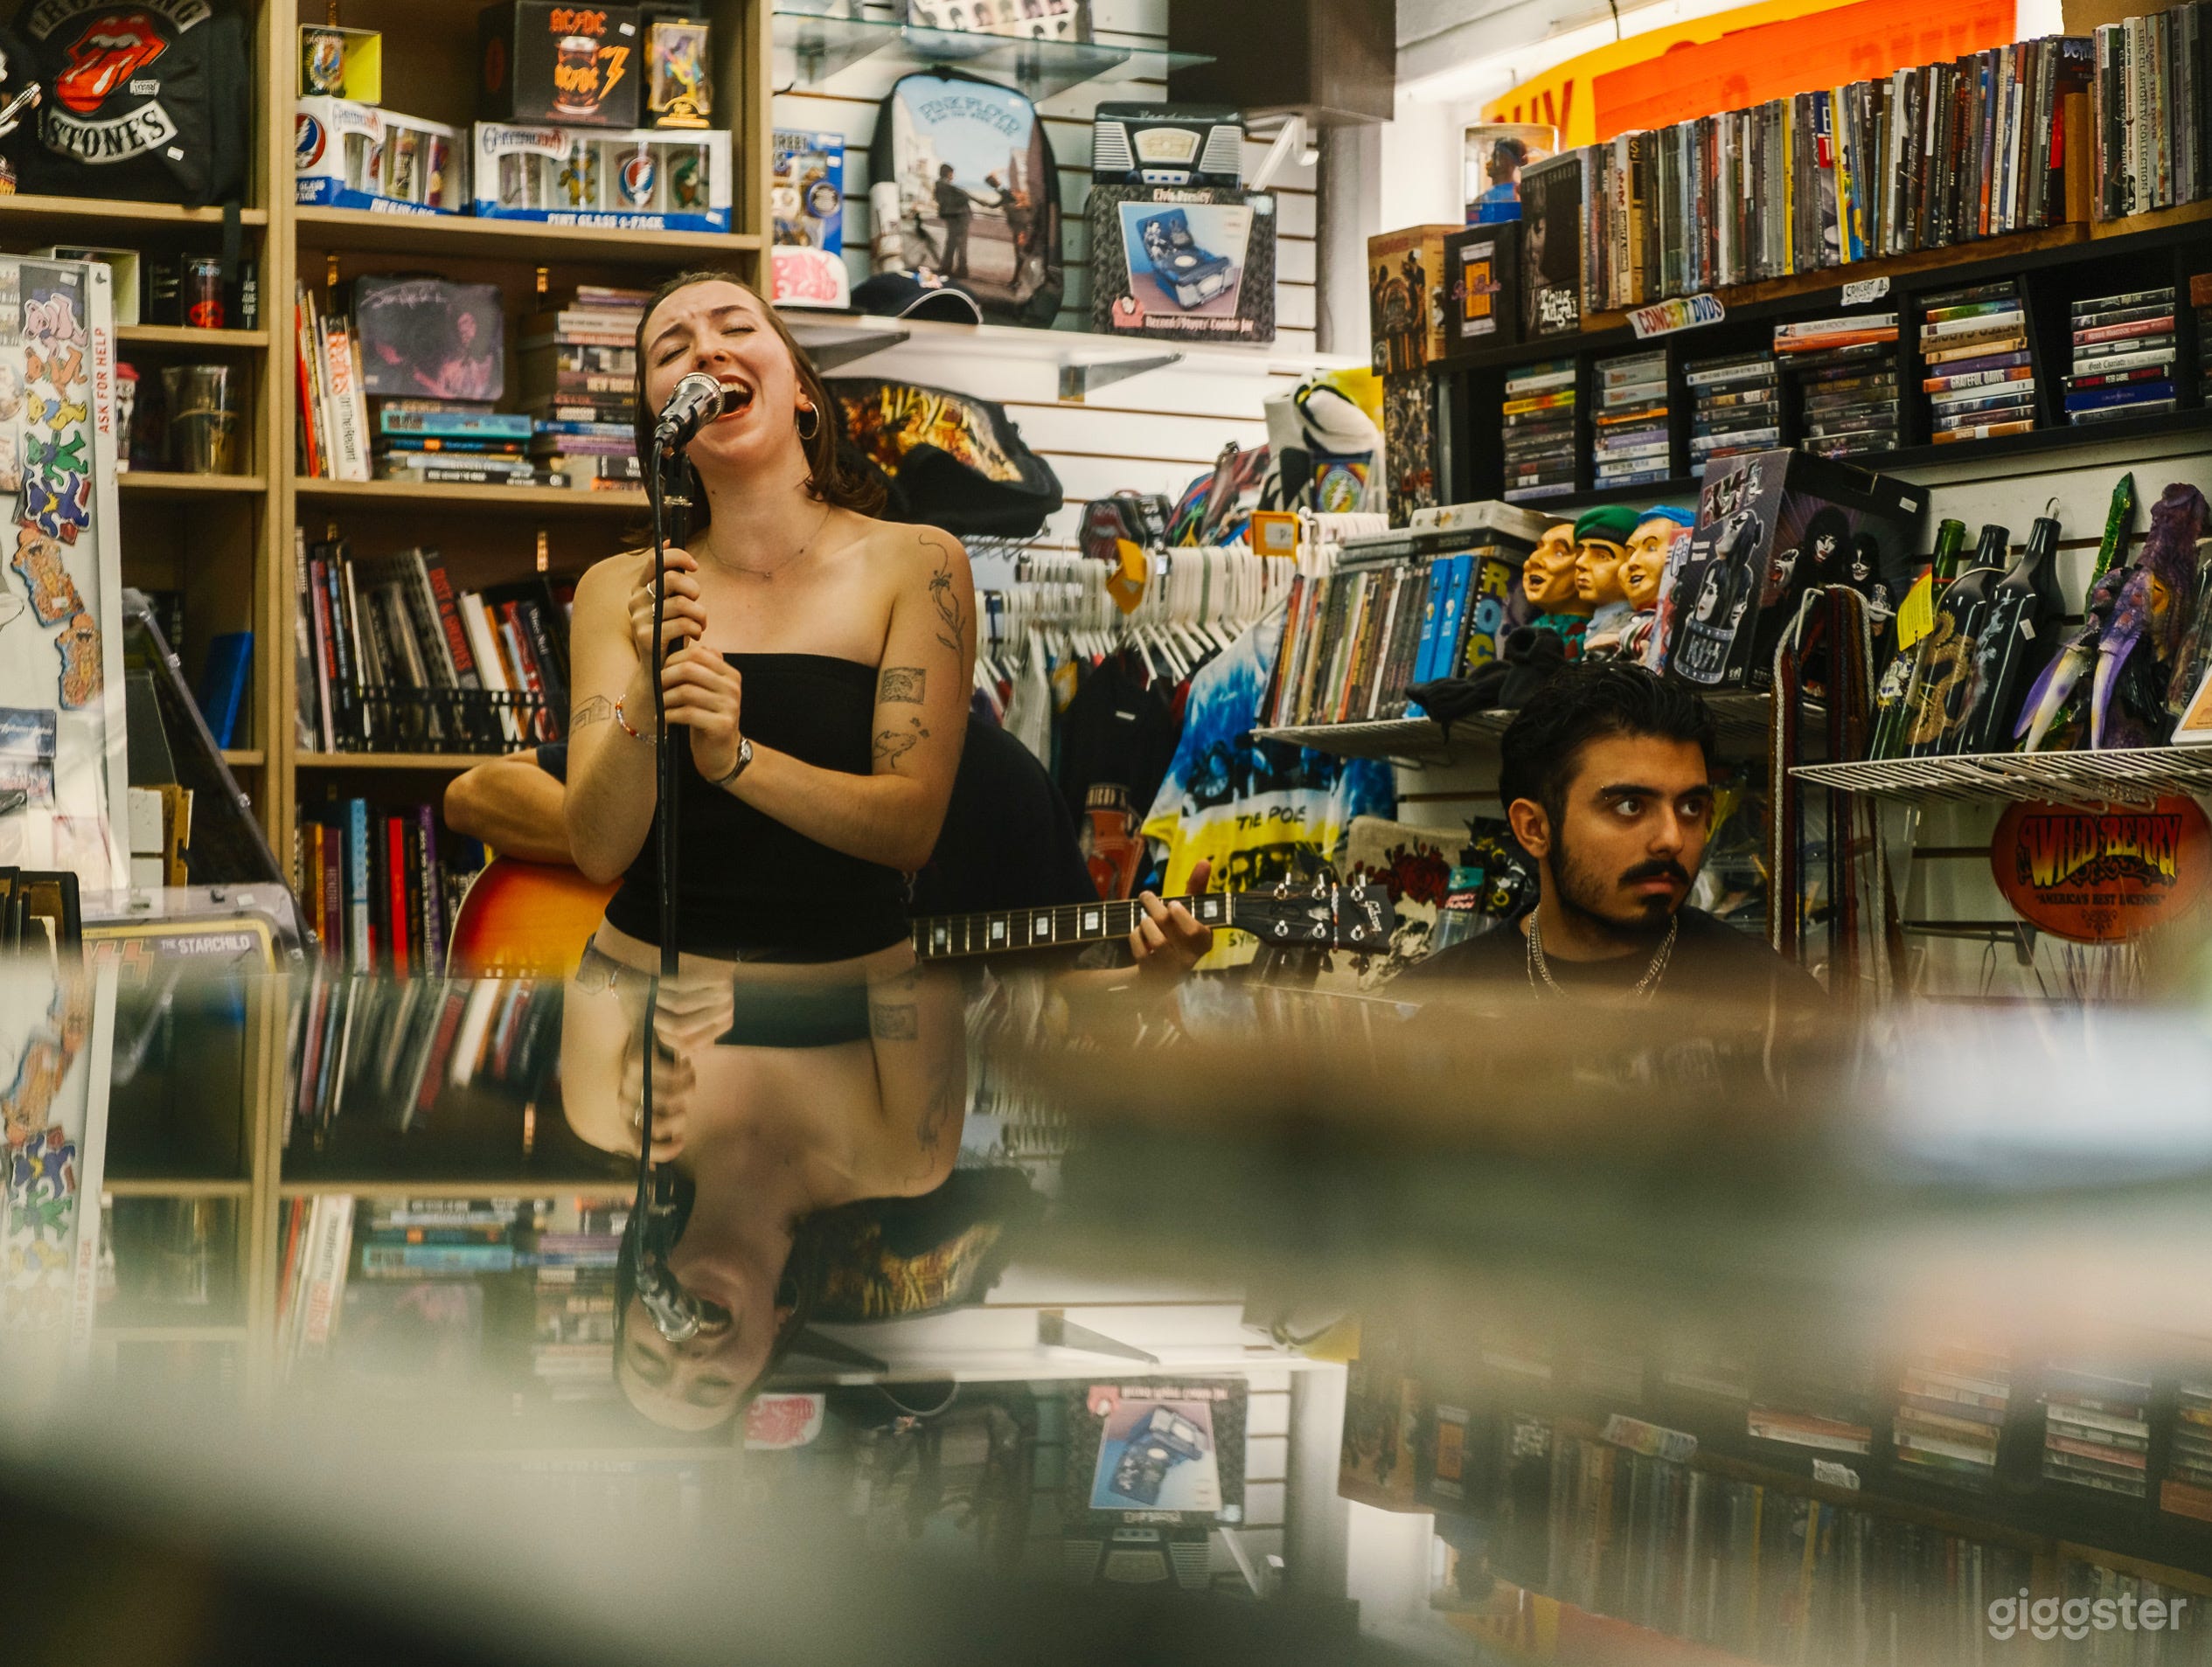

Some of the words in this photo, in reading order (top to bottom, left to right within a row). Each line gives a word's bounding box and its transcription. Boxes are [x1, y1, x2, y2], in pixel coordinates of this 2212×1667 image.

[549, 7, 608, 36] AC/DC
[2139, 57, 2147, 108] CLAPTON
[48, 109, 165, 157] STONES
[2139, 123, 2148, 191] COLLECTION
[1636, 301, 1691, 335] CONCERT
[1689, 295, 1723, 323] DVDS
[94, 328, 107, 366] HELP
[96, 371, 108, 399] FOR
[1950, 372, 1983, 390] GRATEFUL
[97, 405, 110, 434] ASK
[536, 634, 550, 656] Neil
[2020, 815, 2098, 887] WILD
[2100, 815, 2182, 879] BERRY
[2092, 893, 2115, 906] BEST
[160, 938, 177, 950] THE
[177, 934, 250, 955] STARCHILD
